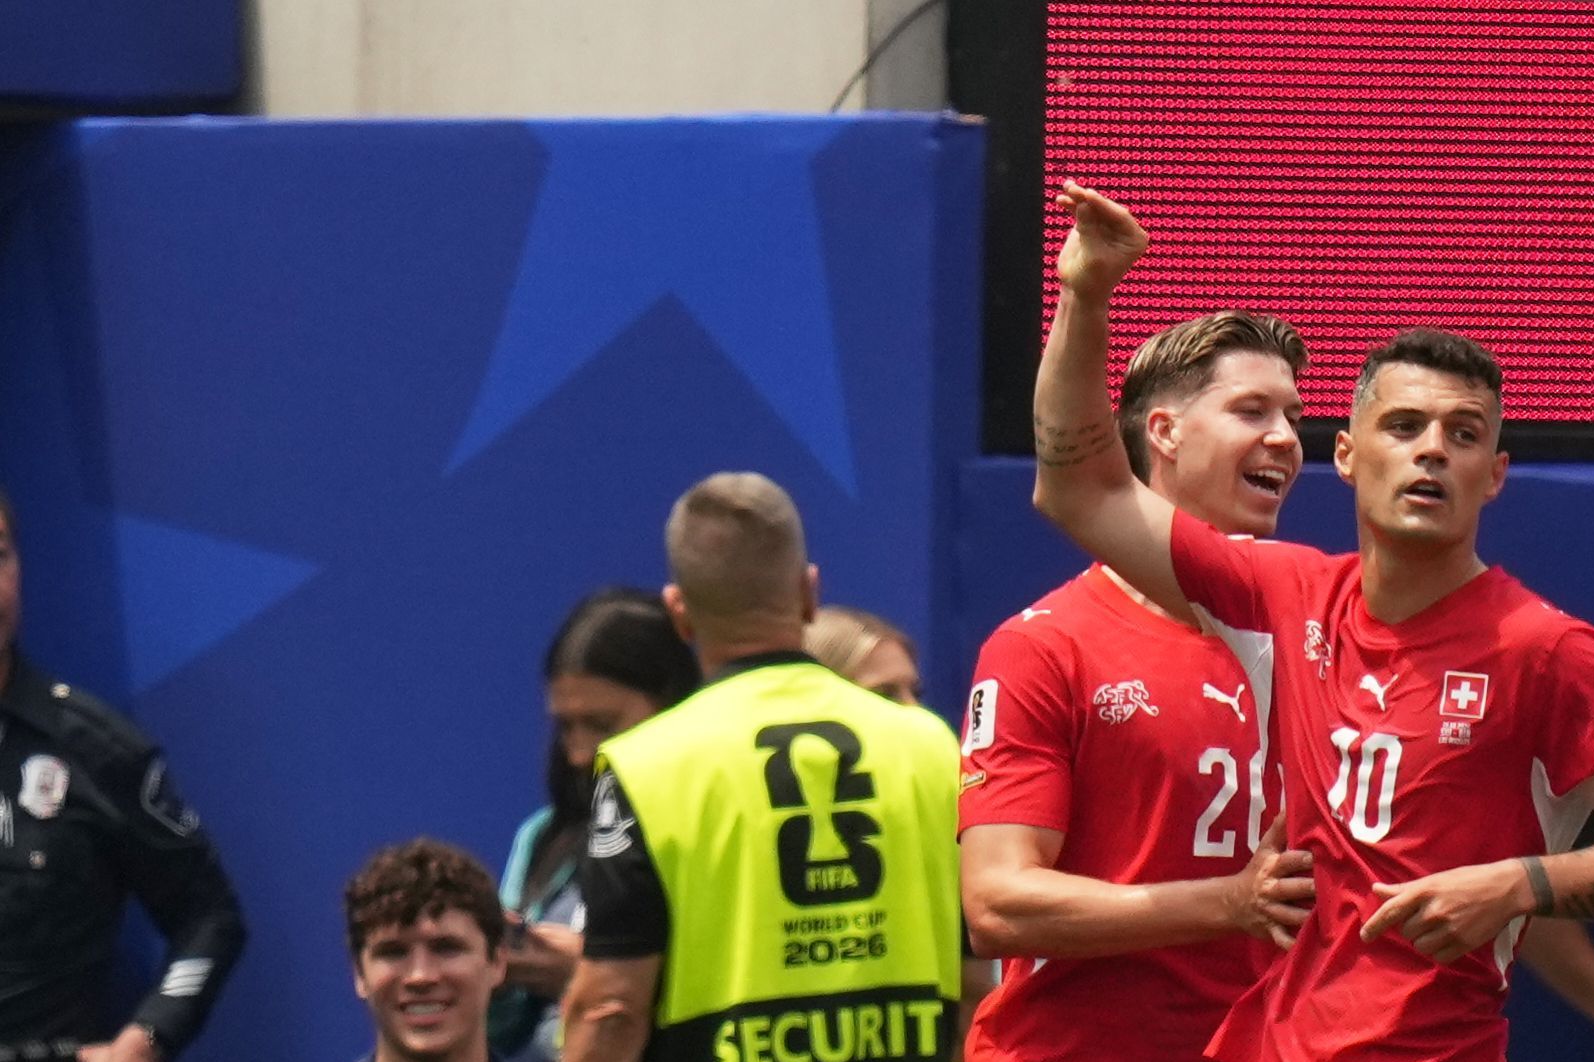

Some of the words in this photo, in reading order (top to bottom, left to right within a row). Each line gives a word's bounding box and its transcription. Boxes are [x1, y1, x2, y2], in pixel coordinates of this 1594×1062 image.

[1328, 726, 1403, 845] 10
[806, 864, 859, 892] FIFA
[784, 932, 889, 969] 2026
